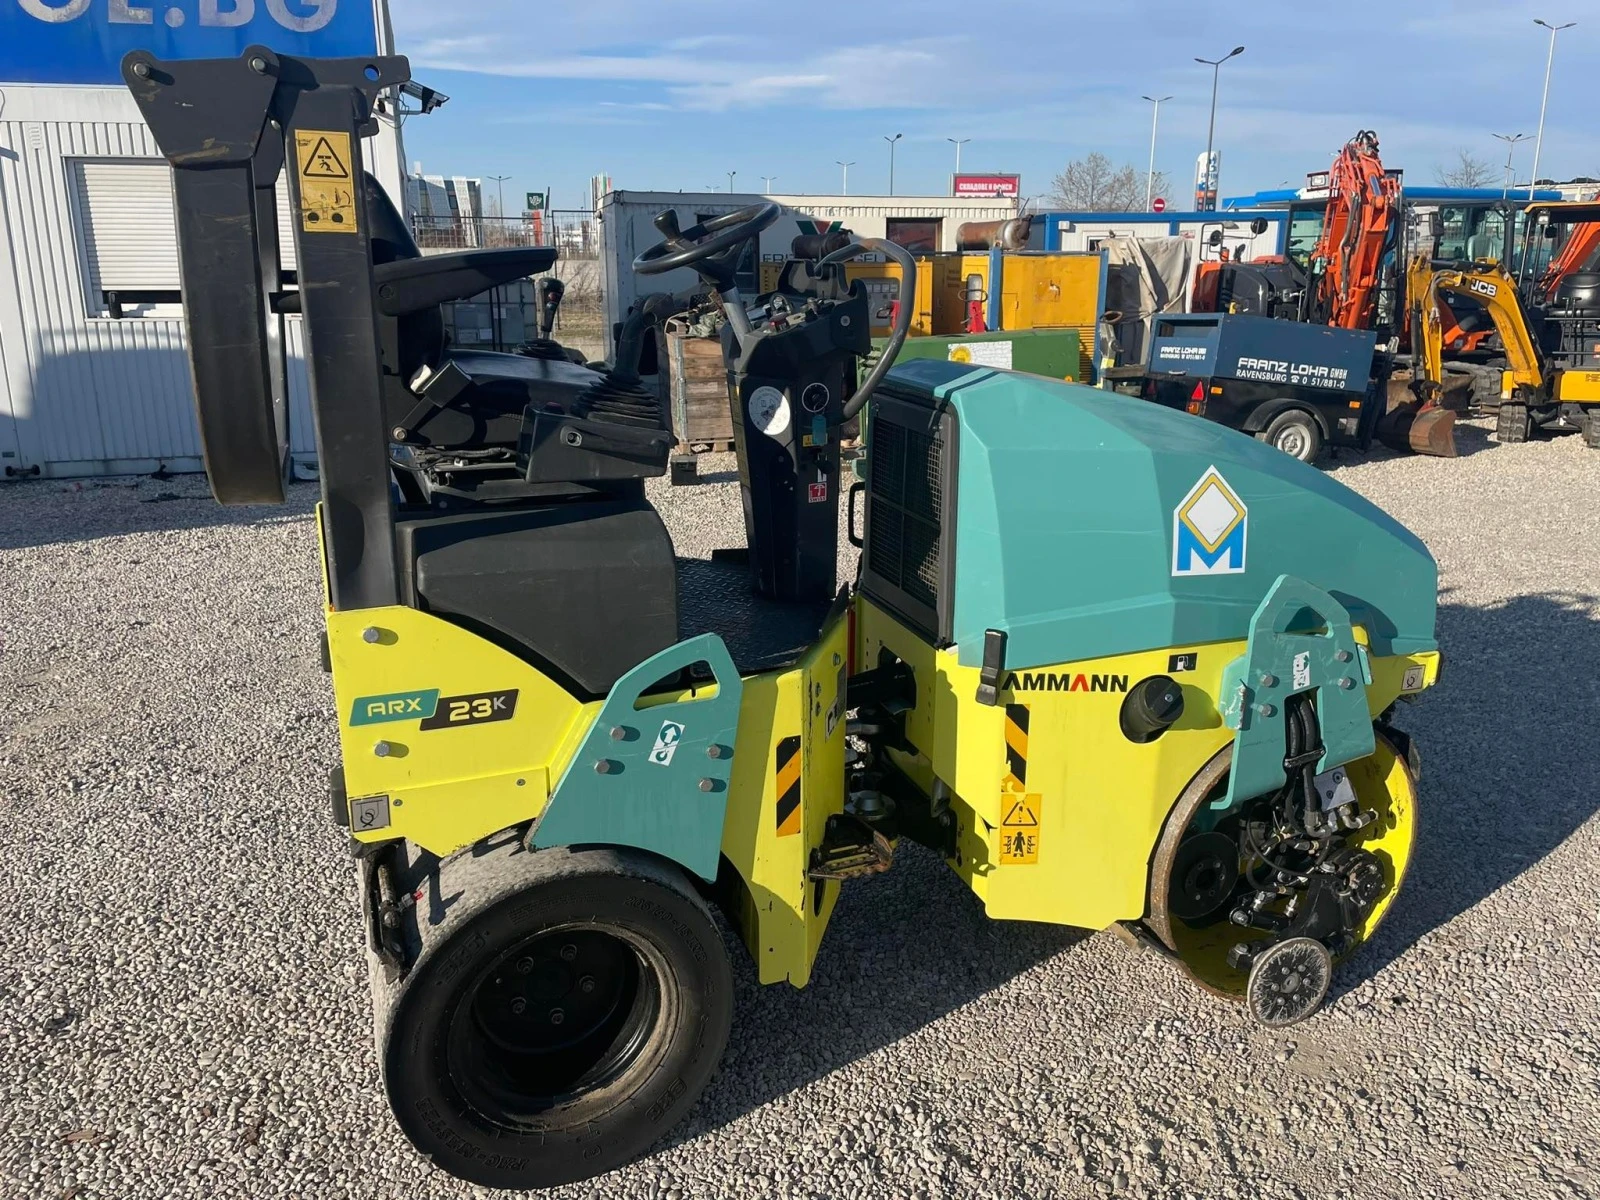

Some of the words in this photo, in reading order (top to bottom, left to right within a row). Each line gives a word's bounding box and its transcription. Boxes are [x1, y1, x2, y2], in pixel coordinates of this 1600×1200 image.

[1470, 279, 1497, 297] JCB
[1236, 369, 1287, 383] RAVENSBURG
[1237, 357, 1288, 373] FRANZ
[1290, 363, 1329, 378] LOHR
[1329, 368, 1348, 380] GMBH
[1001, 672, 1129, 692] AMMANN
[367, 697, 423, 717] ARX
